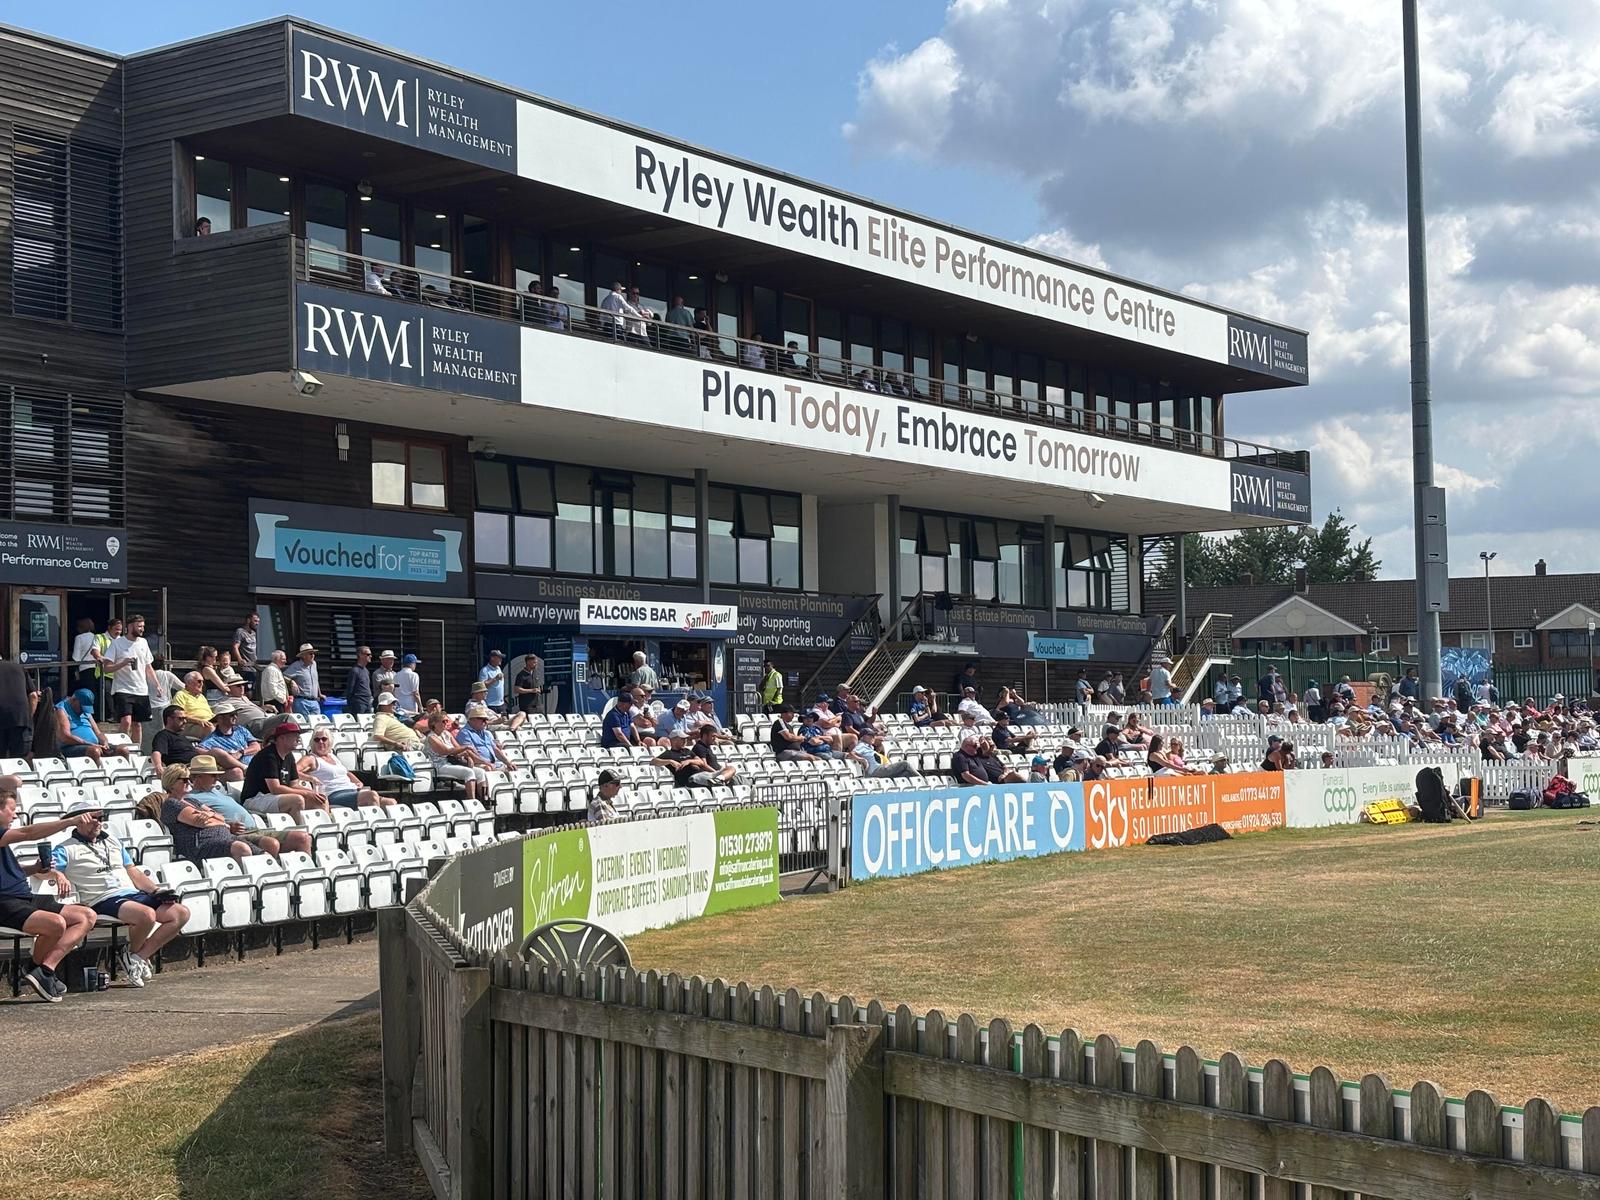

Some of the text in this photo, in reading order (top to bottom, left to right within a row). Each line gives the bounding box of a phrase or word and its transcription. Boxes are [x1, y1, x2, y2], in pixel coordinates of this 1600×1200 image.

[300, 49, 409, 128] RWM
[427, 87, 465, 109] RYLEY
[428, 105, 479, 131] WEALTH
[428, 122, 513, 158] MANAGEMENT
[635, 145, 1176, 337] Ryley Wealth Elite Performance Centre
[304, 302, 413, 369] RWM
[432, 326, 470, 344] RYLEY
[1273, 338, 1288, 350] RYLEY
[432, 343, 483, 364] WEALTH
[1229, 326, 1268, 365] RWM
[1274, 349, 1294, 361] WEALTH
[432, 361, 517, 386] MANAGEMENT
[1274, 359, 1306, 375] MANAGEMENT
[702, 368, 1140, 482] Plan Today, Embrace Tomorrow
[1232, 472, 1271, 507] RWM
[1276, 480, 1291, 491] RYLEY
[1276, 491, 1296, 501] WEALTH
[1277, 501, 1309, 513] MANAGEMENT
[0, 532, 18, 540] come
[7, 540, 18, 548] the
[27, 534, 61, 550] RWM
[1, 553, 109, 570] Performance Centre
[421, 551, 439, 559] RATED
[538, 580, 641, 600] Business Advice
[496, 603, 580, 625] www.ryleyw
[587, 604, 677, 622] FALCONS BAR
[738, 593, 844, 617] Investment Planning
[737, 615, 811, 634] udly Supporting
[974, 609, 999, 622] Estate
[1000, 611, 1035, 628] Planning
[1077, 615, 1147, 634] Retirement Planning
[747, 632, 780, 649] County
[782, 633, 814, 647] Cricket
[815, 636, 836, 648] Club
[1322, 773, 1344, 786] Funeral
[1362, 782, 1378, 796] Every
[1378, 781, 1388, 792] life
[1388, 782, 1393, 792] is
[1131, 784, 1207, 810] RECRUITMENT
[1240, 787, 1258, 802] 01773
[1258, 786, 1269, 800] 441
[1270, 786, 1281, 800] 297
[1089, 782, 1128, 849] Sky
[1242, 813, 1260, 829] 01924
[1260, 812, 1272, 828] 284
[1272, 812, 1282, 826] 533
[1132, 812, 1208, 840] SOLUTIONS LTD
[719, 830, 773, 858] 01530 273879
[596, 844, 687, 884] CATERING EVENTS WEDDINGS
[596, 869, 709, 918] CORPORATE BUFFETS SANDWICH VANS
